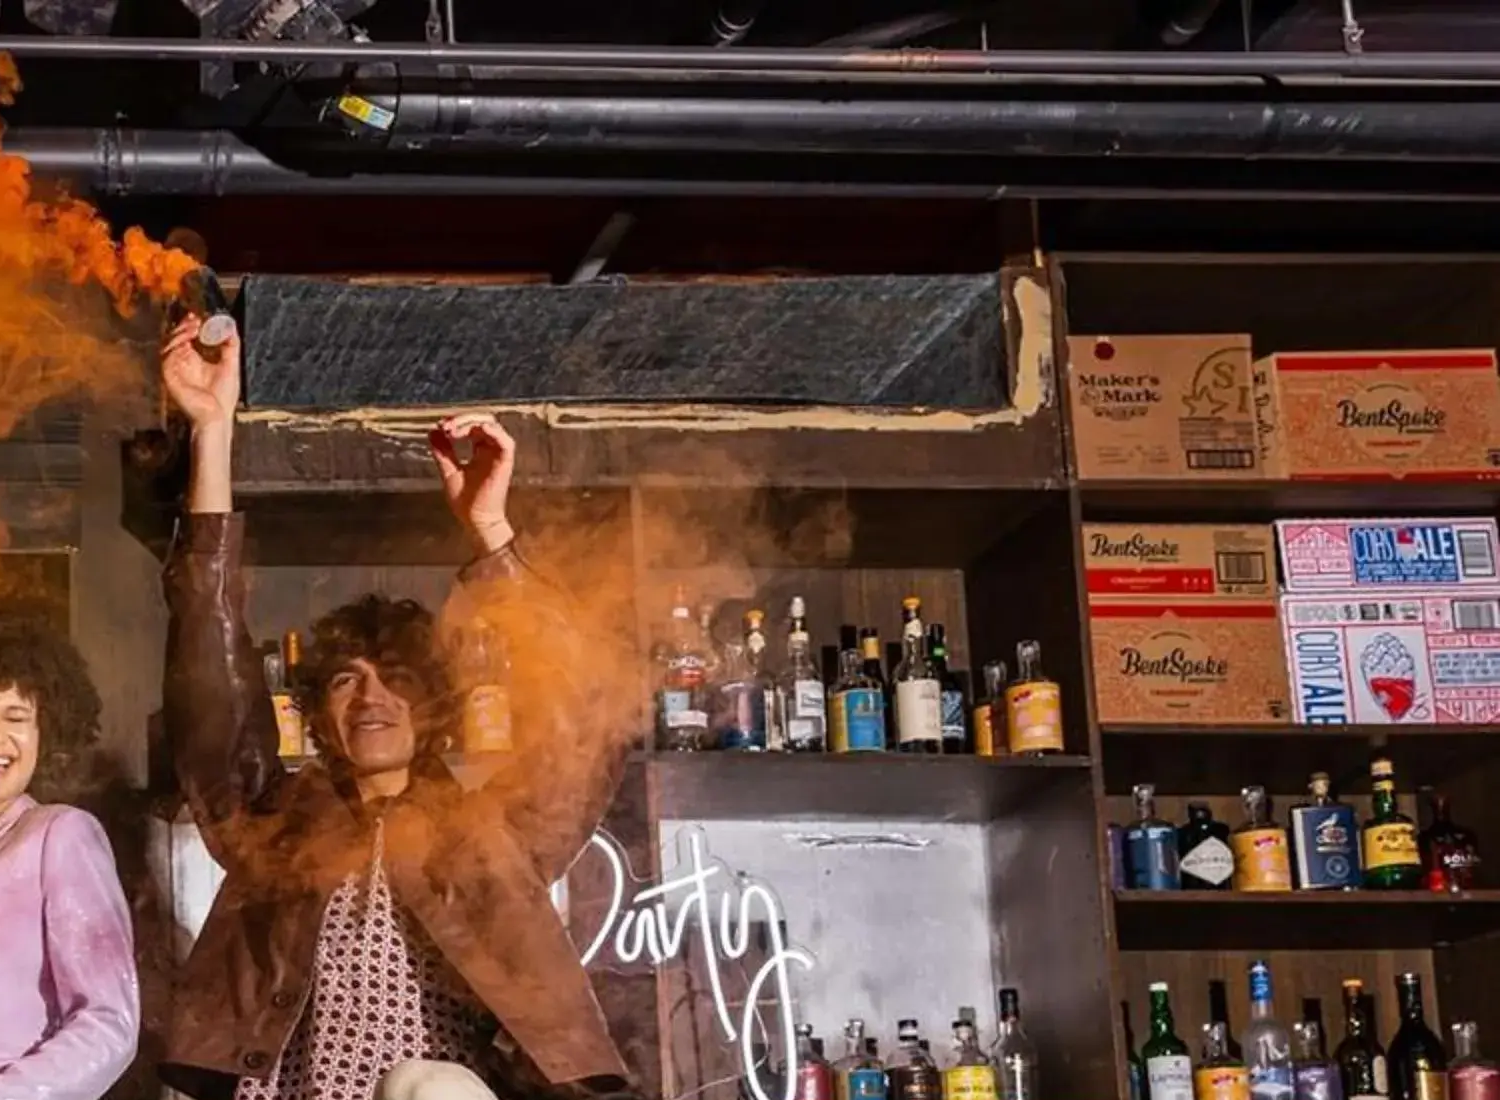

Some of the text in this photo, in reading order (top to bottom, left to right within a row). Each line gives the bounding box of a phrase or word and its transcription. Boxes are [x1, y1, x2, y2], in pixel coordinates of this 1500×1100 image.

[1078, 373, 1161, 388] Maker's
[1102, 388, 1161, 403] Mark
[1336, 399, 1447, 434] BentSpoke
[1090, 532, 1179, 562] BentSpoke
[1411, 527, 1456, 561] ALE
[1119, 647, 1229, 683] BentSpoke
[1295, 631, 1345, 682] COAST
[1302, 683, 1348, 724] ALE
